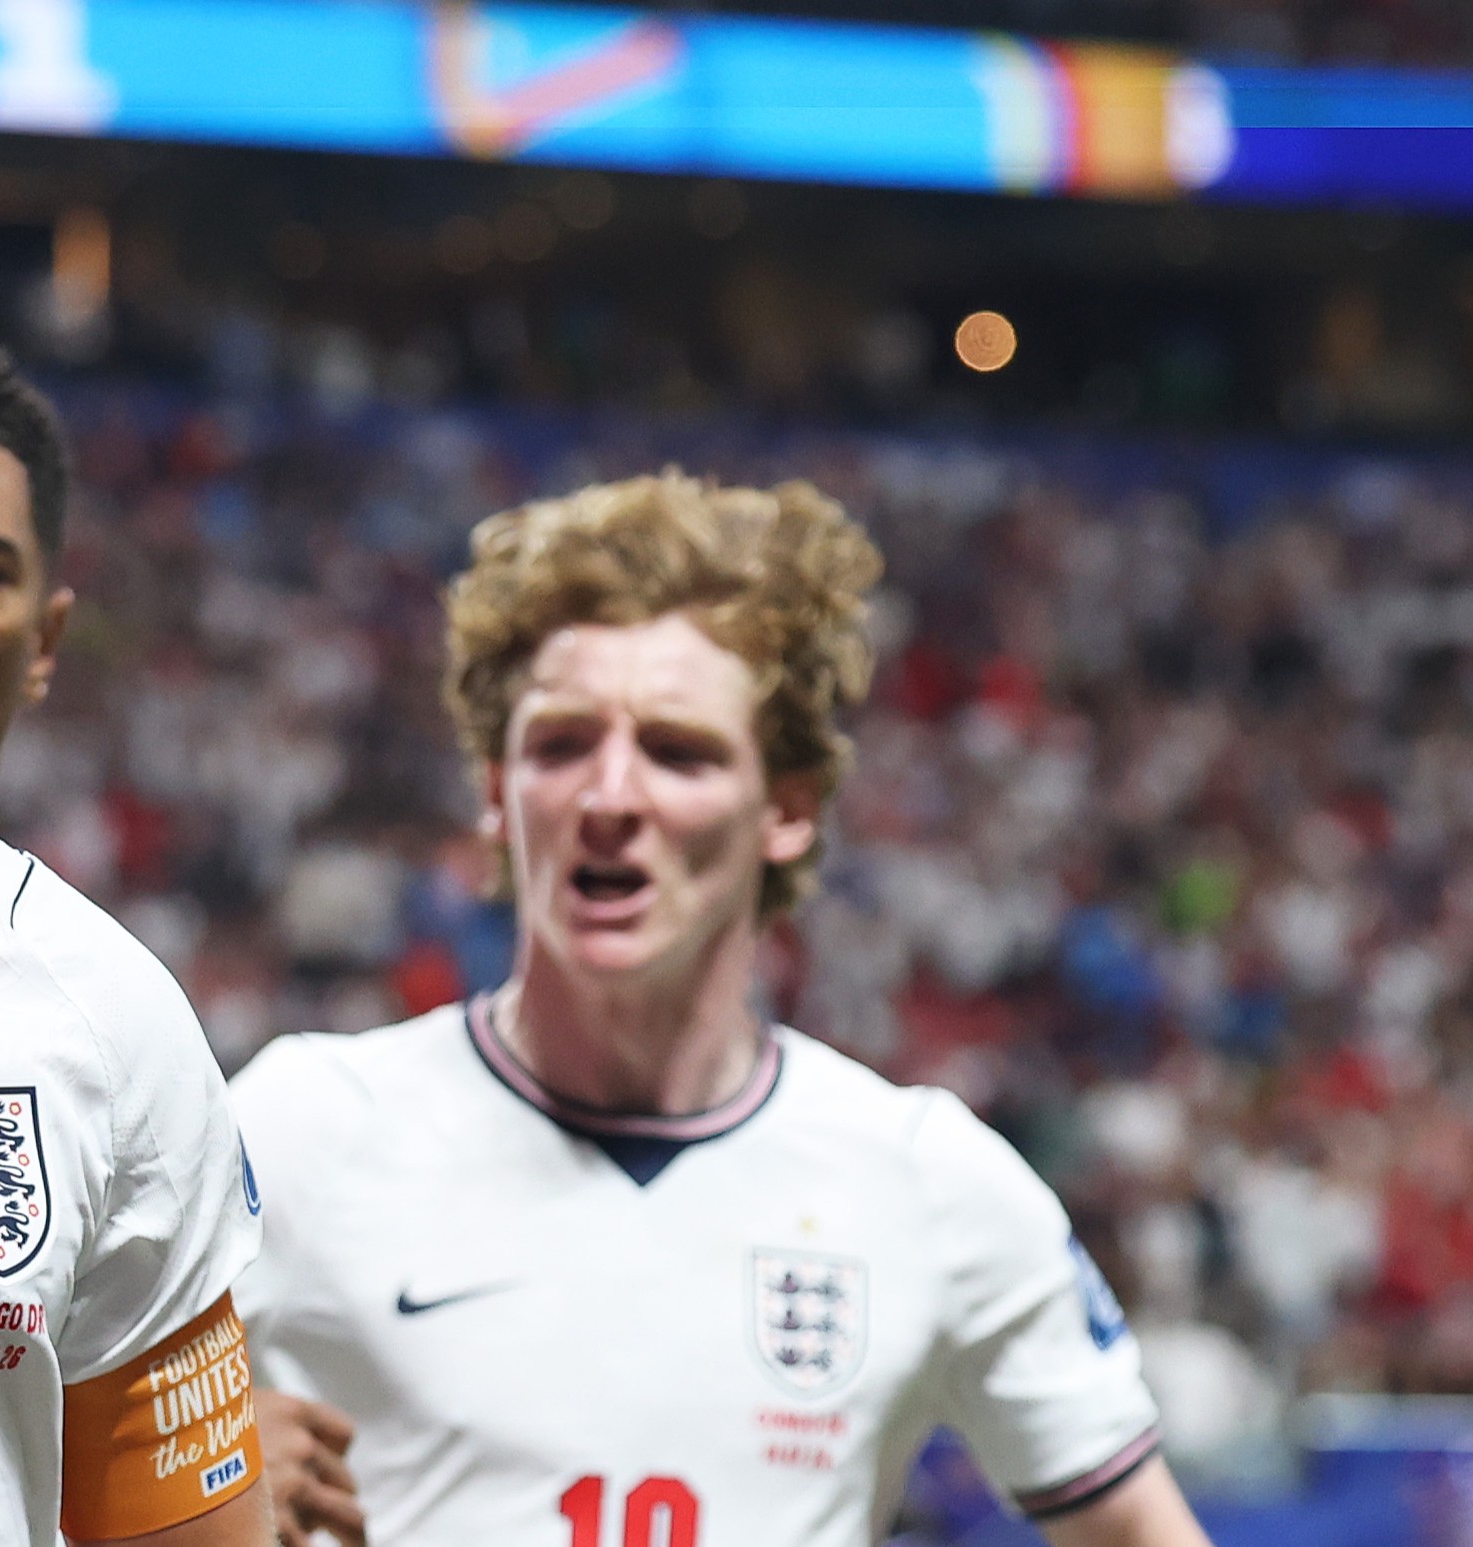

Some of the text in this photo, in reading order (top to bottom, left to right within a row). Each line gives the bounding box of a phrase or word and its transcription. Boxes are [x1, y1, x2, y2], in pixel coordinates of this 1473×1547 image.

[149, 1311, 244, 1392] FOOTBALL
[153, 1344, 250, 1435] UNITES
[149, 1436, 205, 1479] the
[206, 1457, 243, 1490] FIFA
